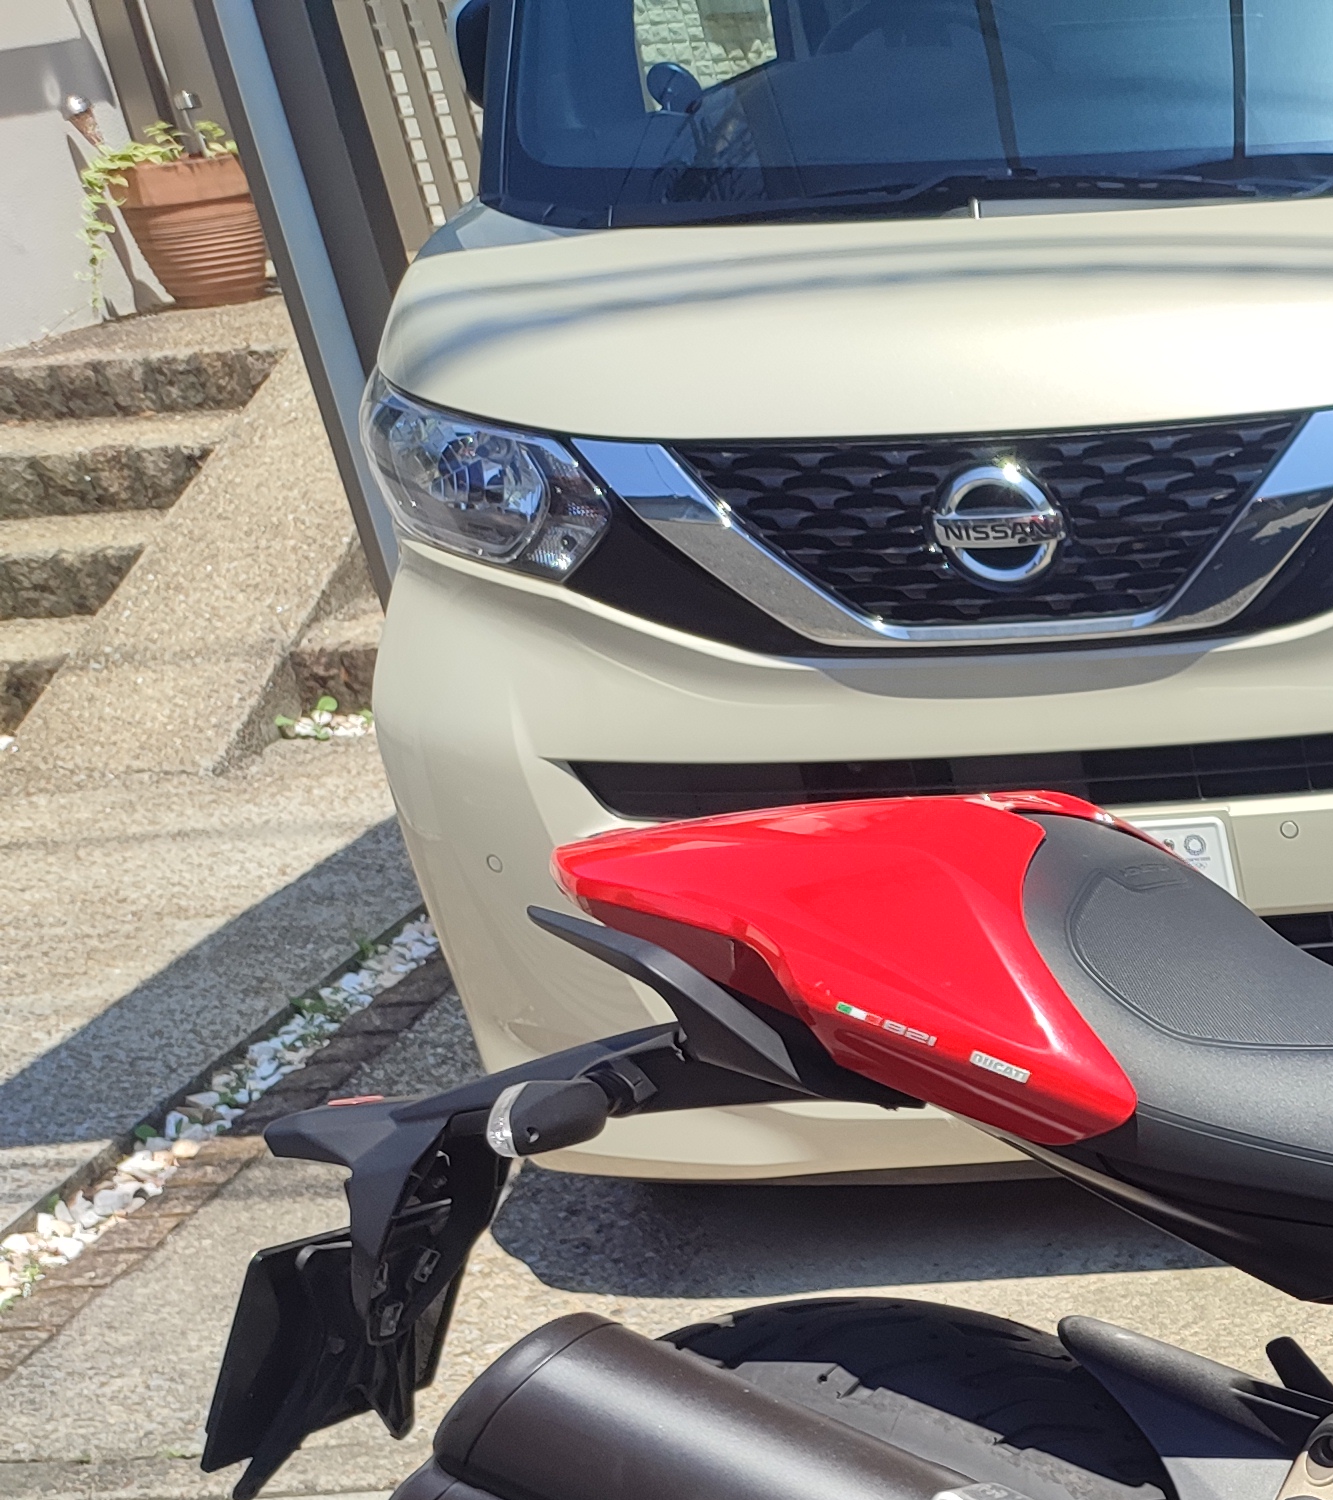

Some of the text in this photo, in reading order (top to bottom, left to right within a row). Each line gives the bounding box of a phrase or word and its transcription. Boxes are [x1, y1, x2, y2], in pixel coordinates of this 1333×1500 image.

[943, 518, 1056, 542] NISSAN
[883, 1018, 938, 1048] 821
[971, 1051, 1030, 1083] DUCATI
